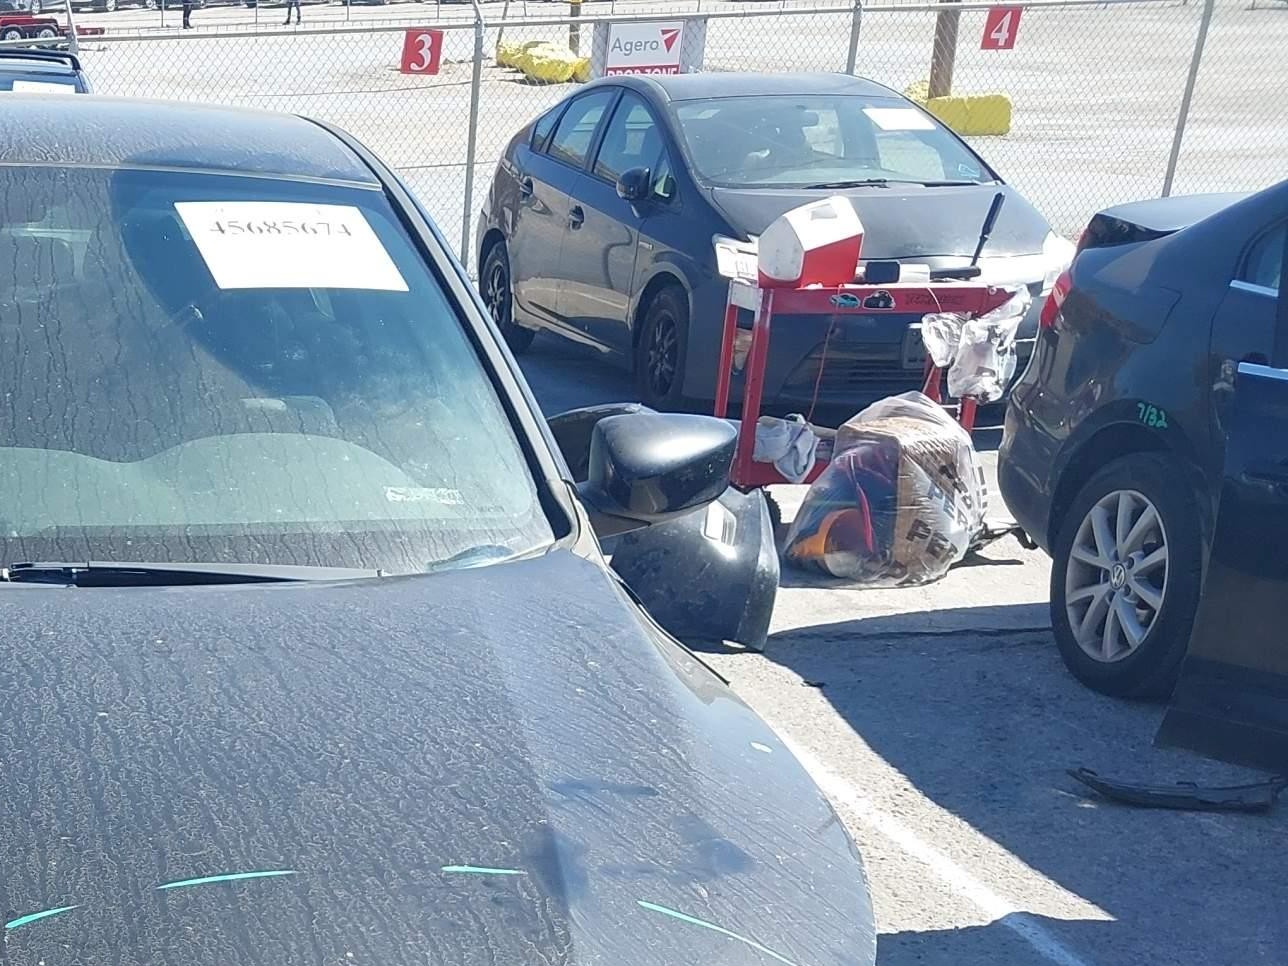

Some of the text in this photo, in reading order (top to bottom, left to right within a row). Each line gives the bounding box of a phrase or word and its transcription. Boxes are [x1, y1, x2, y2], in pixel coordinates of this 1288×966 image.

[990, 10, 1012, 46] 4
[410, 33, 432, 70] 3
[611, 38, 659, 56] Agero
